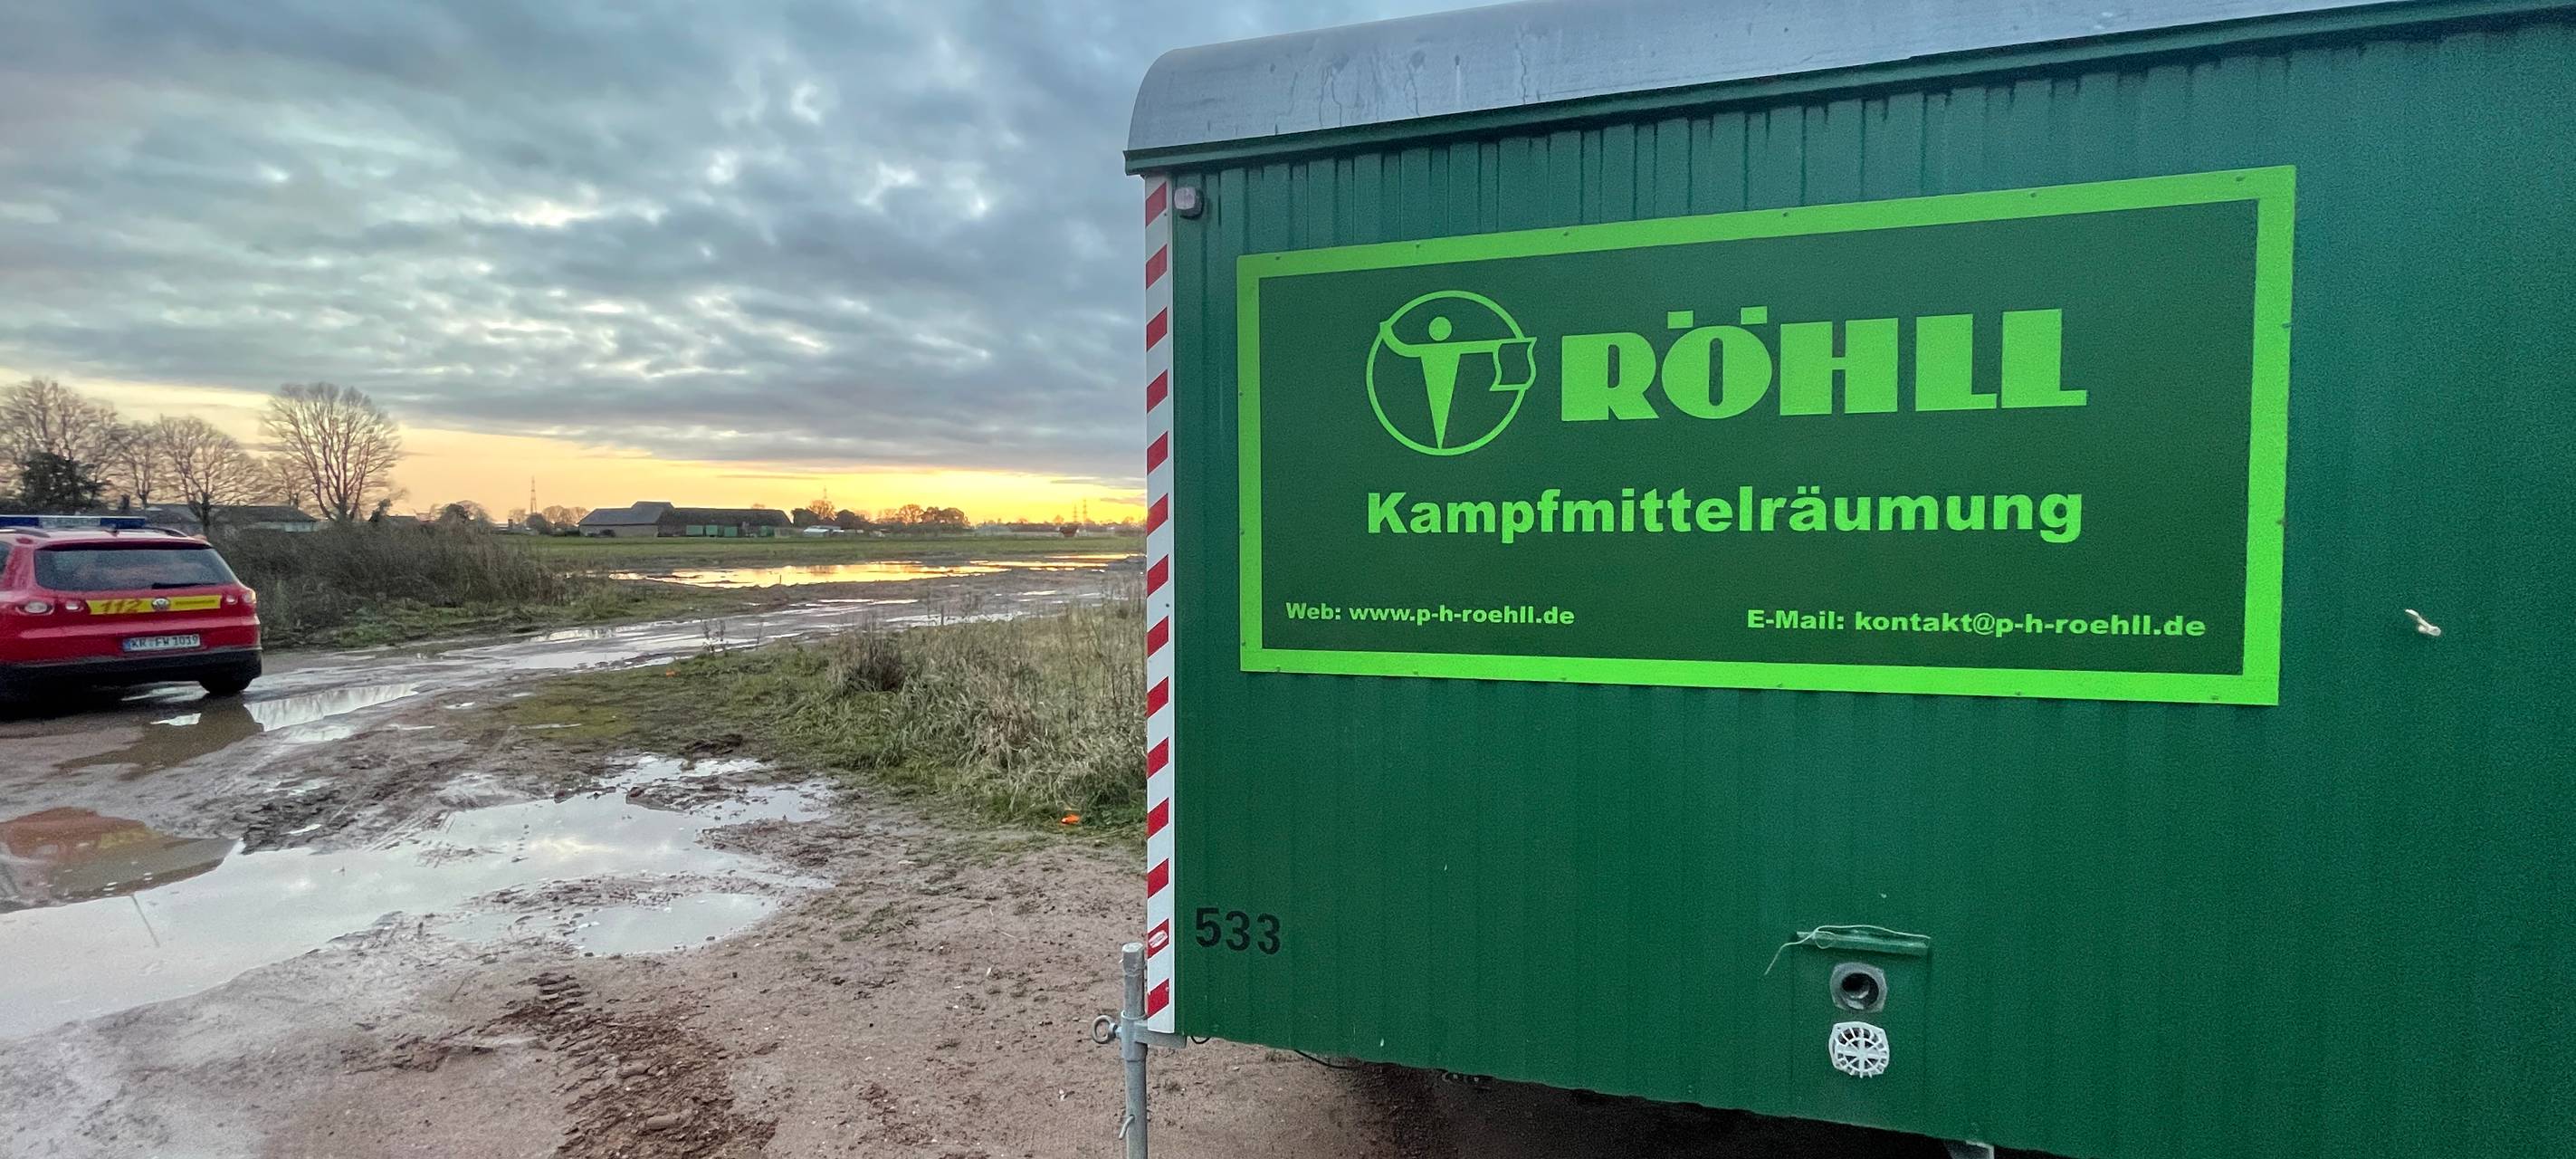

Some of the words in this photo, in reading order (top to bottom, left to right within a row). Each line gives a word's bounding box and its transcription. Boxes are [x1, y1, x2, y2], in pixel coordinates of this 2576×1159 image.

[1560, 306, 2086, 422] RÖHLL
[1368, 485, 2083, 544] Kampfmittelräumung
[100, 599, 142, 614] 112
[1285, 601, 1341, 620] Web:
[1349, 603, 1575, 627] www.p-h-roehll.de
[1748, 609, 1845, 632] E-Mail:
[1855, 610, 2206, 638] kontakt@p-h-roehll.de
[130, 637, 148, 649] KR
[155, 636, 170, 647] FW
[1196, 907, 1281, 955] 533
